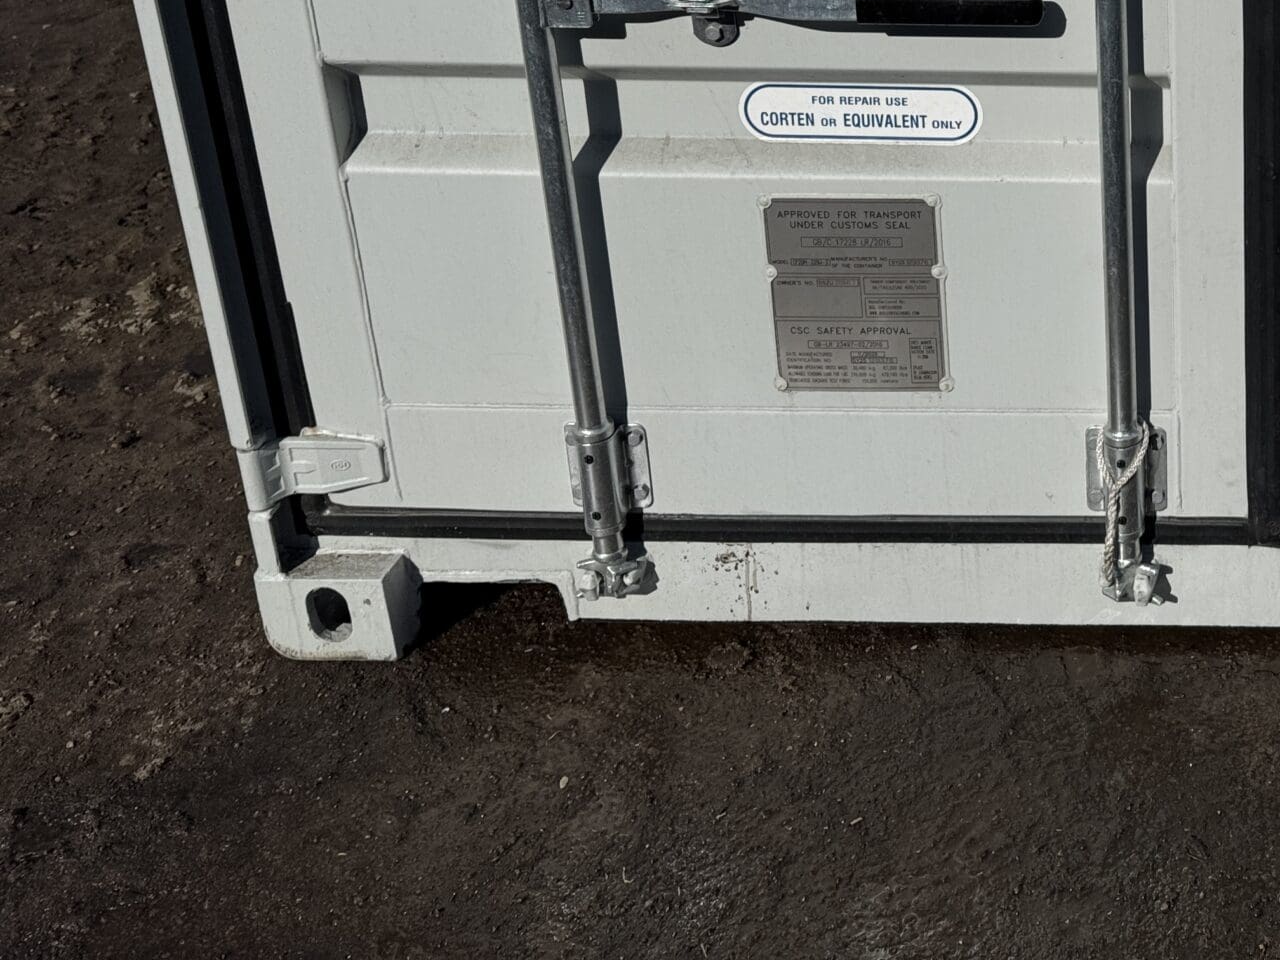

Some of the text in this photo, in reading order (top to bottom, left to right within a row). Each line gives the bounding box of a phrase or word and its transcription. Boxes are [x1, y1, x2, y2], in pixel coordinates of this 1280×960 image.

[811, 95, 909, 107] FOR REPAIR USE
[760, 111, 963, 130] CORTEN OR EQUIVALENT ONLY
[776, 210, 923, 220] APPROVED FOR TRANSPORT
[789, 221, 911, 230] UNDER CUSTOMS SEAL
[790, 326, 912, 336] CSC SAFETY APPROVAL
